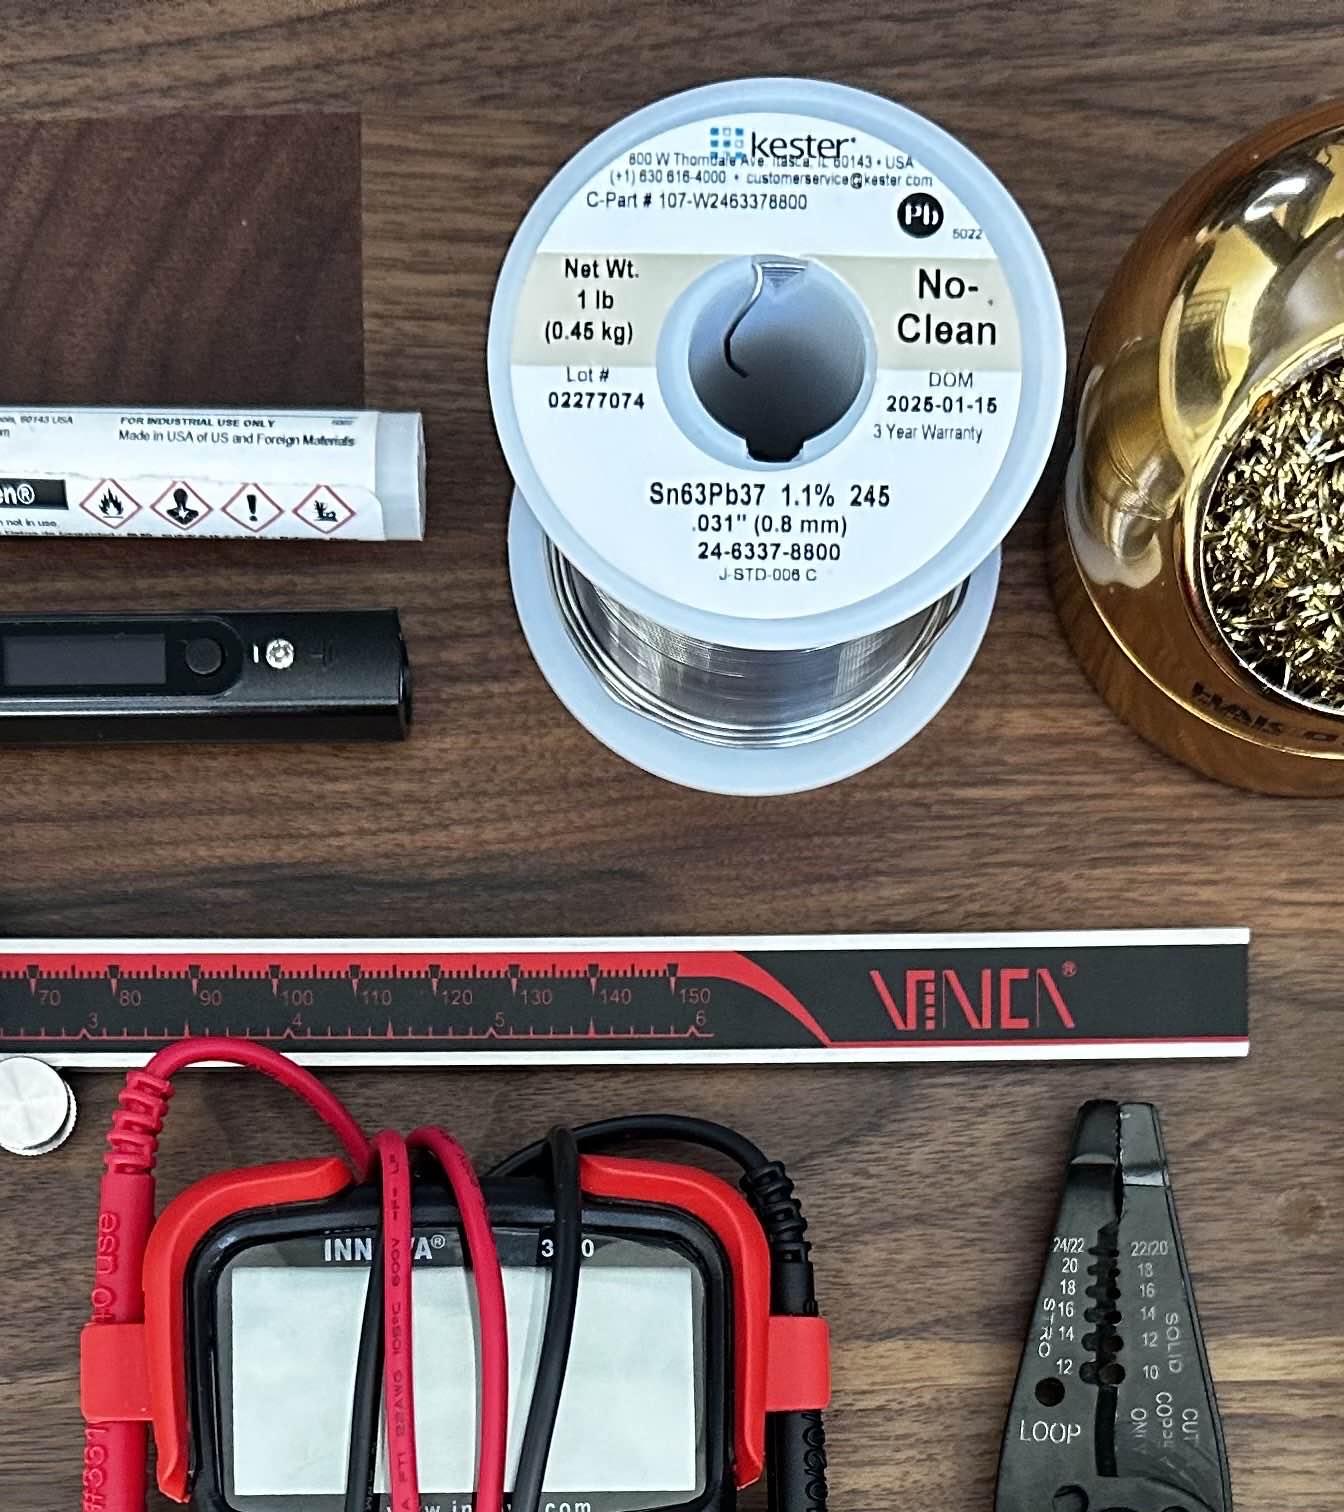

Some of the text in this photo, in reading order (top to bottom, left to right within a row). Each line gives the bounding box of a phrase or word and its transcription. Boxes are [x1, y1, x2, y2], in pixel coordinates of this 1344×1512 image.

[751, 132, 850, 159] kester
[629, 152, 914, 169] 800 W USA
[609, 170, 726, 184] (+1) 630 616-4000
[586, 192, 638, 209] C-Part
[643, 192, 652, 208] #
[905, 203, 939, 226] Pb
[565, 258, 639, 279] Net Wt.
[918, 268, 979, 300] No-
[577, 289, 614, 310] 1 lb
[545, 321, 634, 346] (0.45 kg)
[897, 313, 997, 346] Clean
[566, 366, 610, 382] Lot #
[929, 372, 974, 388] DOM
[548, 391, 645, 409] 02277074
[886, 395, 998, 414] 2025-01-15
[120, 417, 275, 428] FOR INDUSTRIAL USE ONLY
[119, 430, 355, 448] Made in USA of US and Foreign Materials
[873, 424, 983, 444] 3 Year Warranty
[649, 482, 891, 507] Sn63Pb37 1.1% 245
[6, 518, 24, 527] not
[25, 518, 36, 527] in
[691, 514, 848, 539] .031" (0.8 mm)
[697, 542, 842, 562] 24-6337-8800
[806, 569, 817, 582] C
[38, 988, 711, 1007] 70 80 90 100 110 120 130 140 150
[88, 1010, 707, 1028] 3 4 5 6
[97, 1212, 120, 1277] use
[1054, 1237, 1085, 1253] 24/22
[1131, 1240, 1169, 1256] 22/20
[391, 1237, 401, 1288] 600V
[1062, 1257, 1078, 1273] 20
[1138, 1262, 1154, 1278] 18
[1060, 1279, 1076, 1296] 18
[1139, 1282, 1155, 1298] 16
[1058, 1301, 1074, 1318] 16
[1140, 1305, 1156, 1321] 14
[1058, 1326, 1074, 1341] 14
[1142, 1331, 1158, 1347] 12
[1165, 1312, 1182, 1374] SOLID
[1056, 1359, 1073, 1376] 12
[1142, 1365, 1159, 1380] 10
[1020, 1419, 1081, 1445] LOOP
